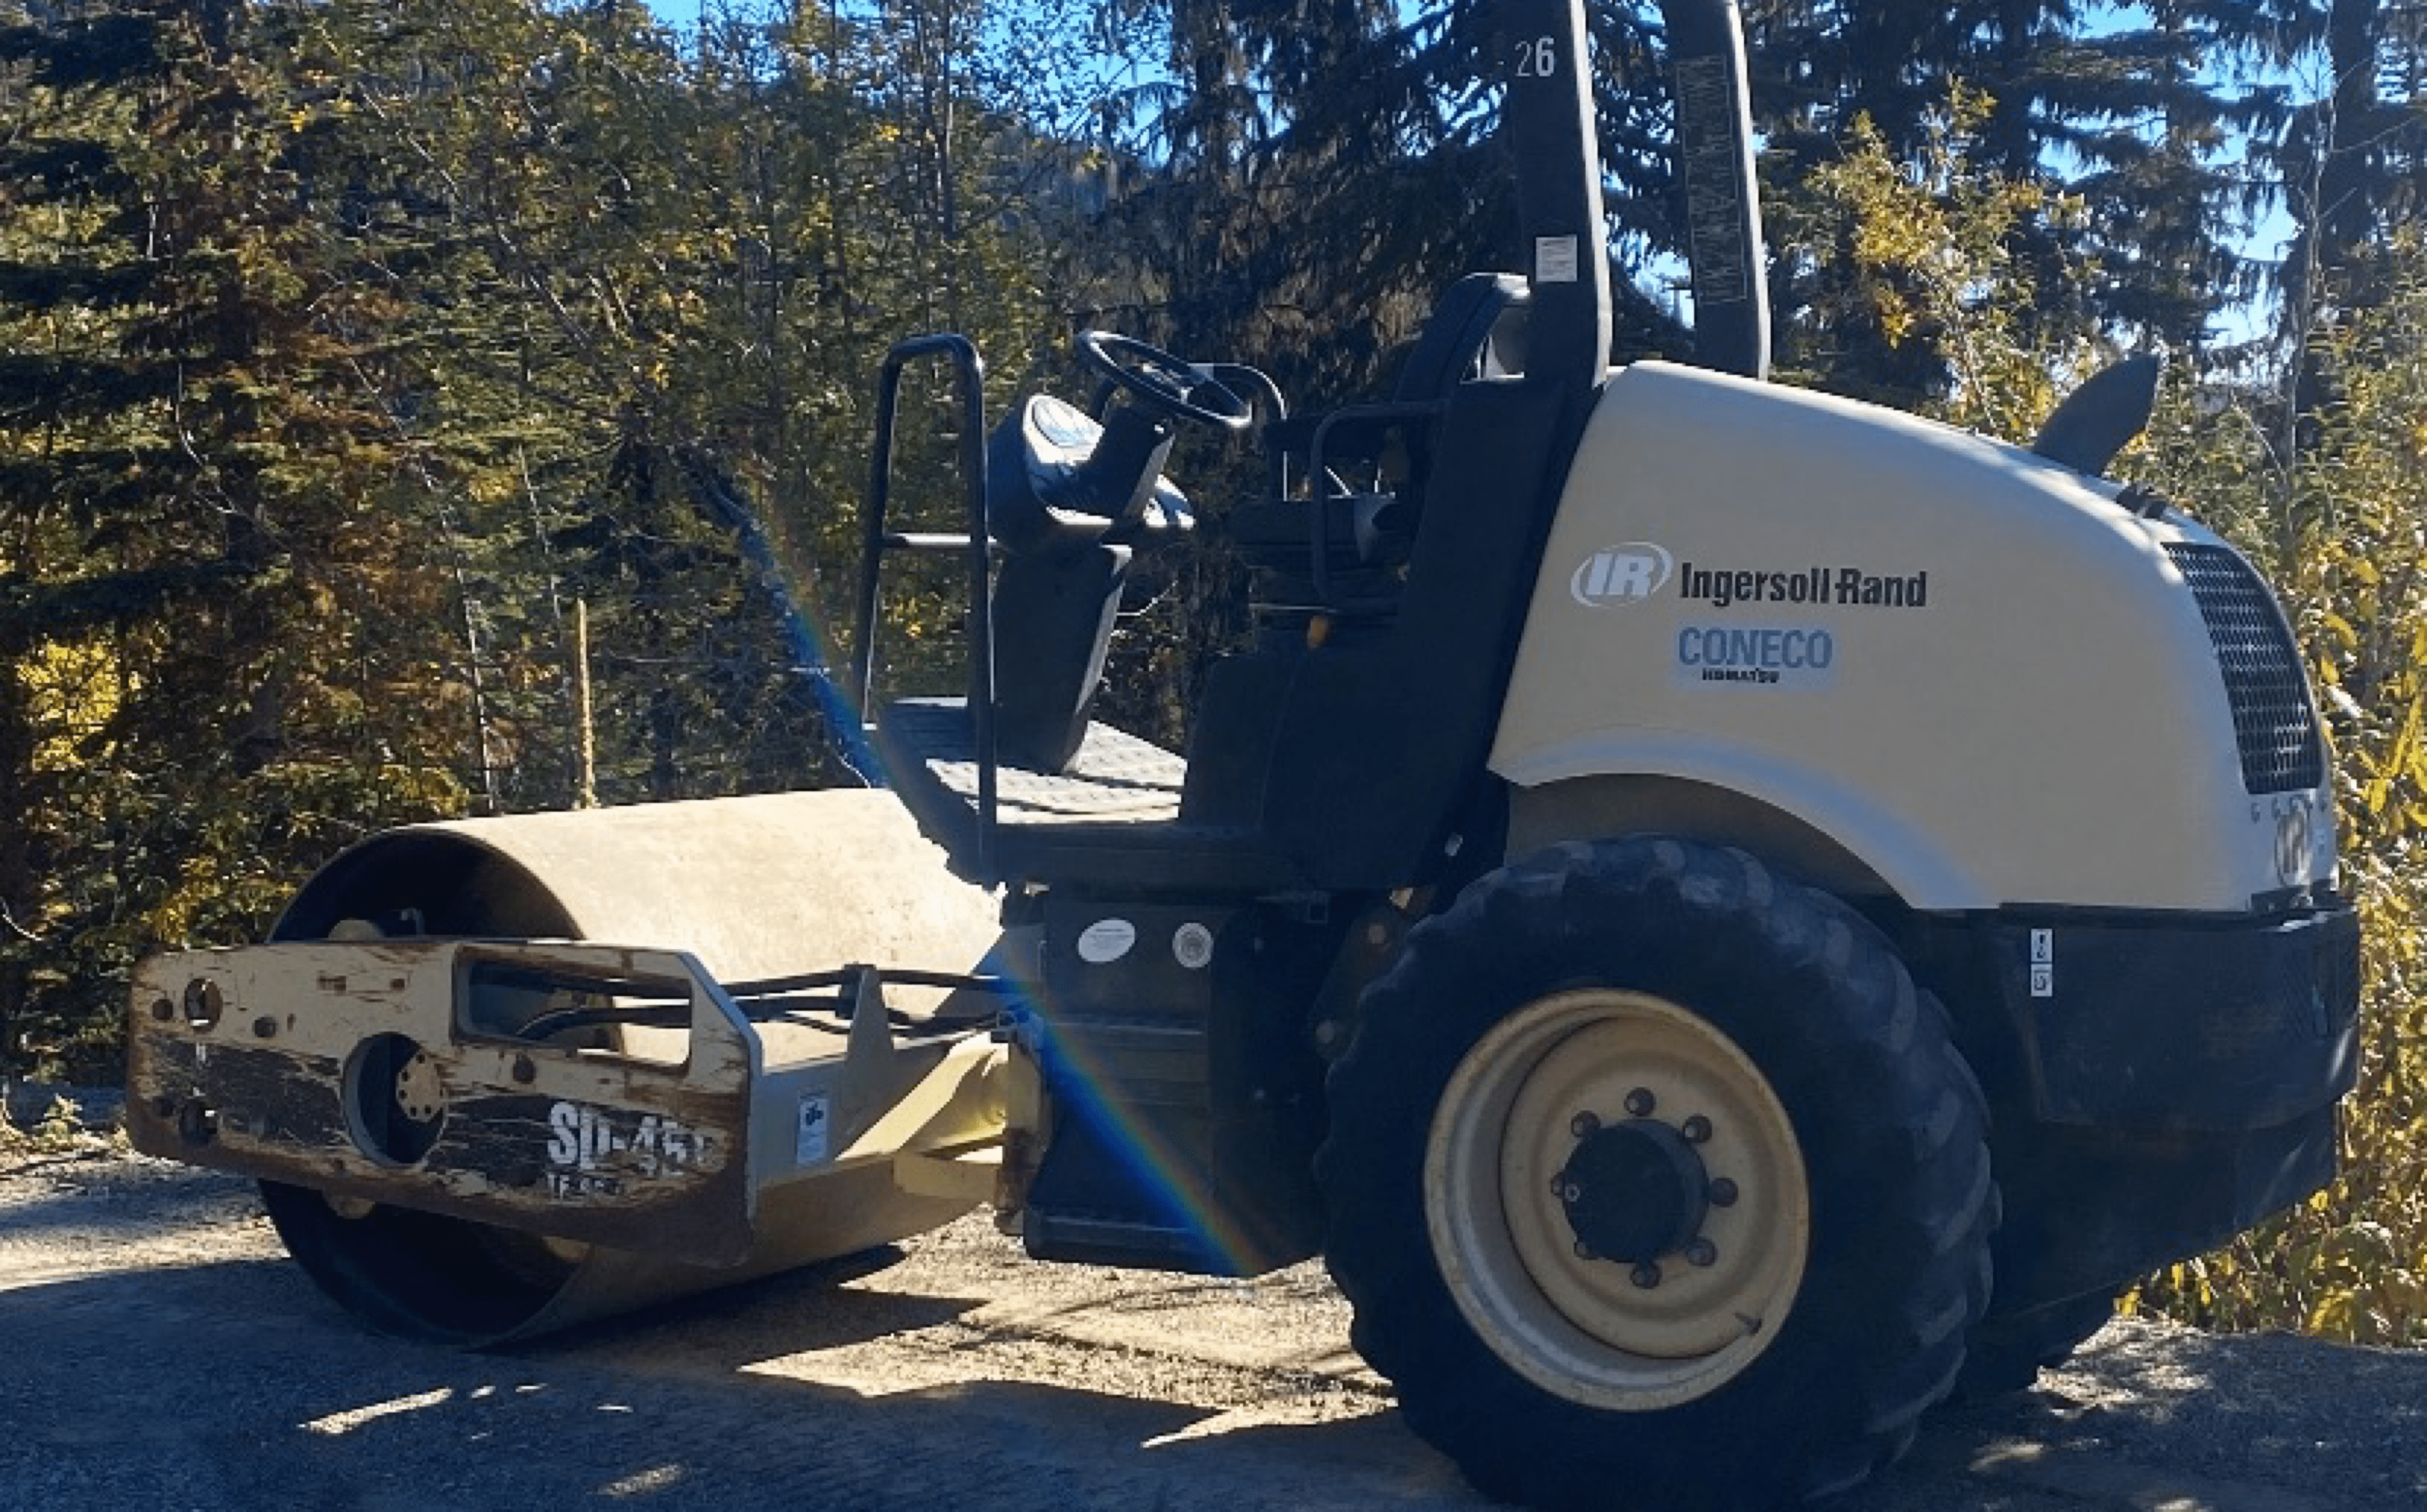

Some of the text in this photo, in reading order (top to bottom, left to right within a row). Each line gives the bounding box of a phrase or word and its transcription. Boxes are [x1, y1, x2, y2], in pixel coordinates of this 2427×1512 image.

[1515, 36, 1555, 77] 26
[1585, 552, 1656, 596] IR
[1681, 562, 1927, 607] Ingersoll-Rand
[1678, 626, 1833, 668] CONECO
